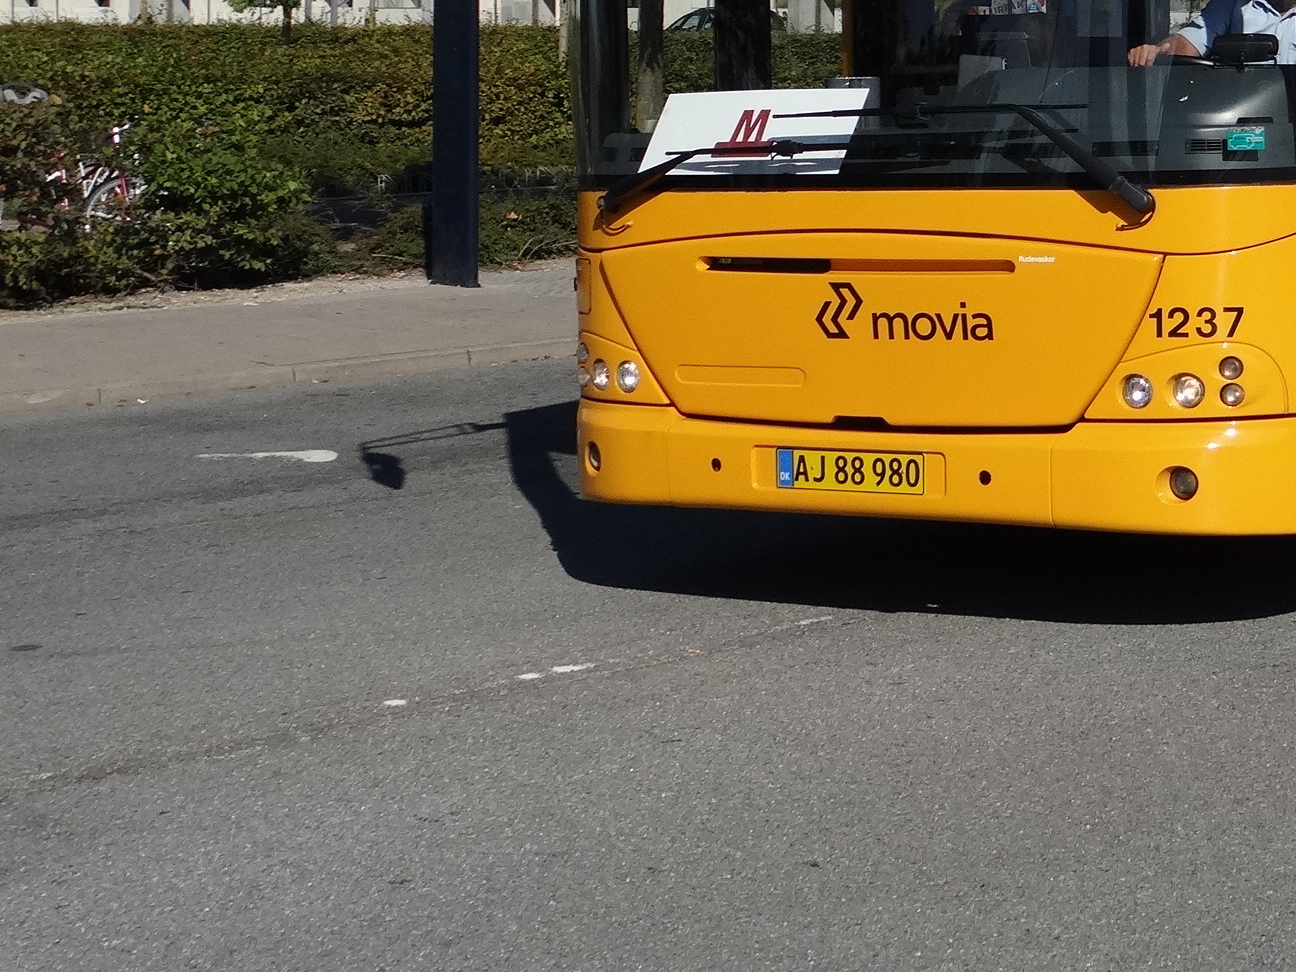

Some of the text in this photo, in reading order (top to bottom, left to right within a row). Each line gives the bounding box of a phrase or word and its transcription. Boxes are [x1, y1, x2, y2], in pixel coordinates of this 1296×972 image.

[728, 108, 772, 144] M
[871, 301, 995, 341] movia
[1148, 307, 1245, 338] 1237
[780, 455, 920, 488] DK AJ 88 980
